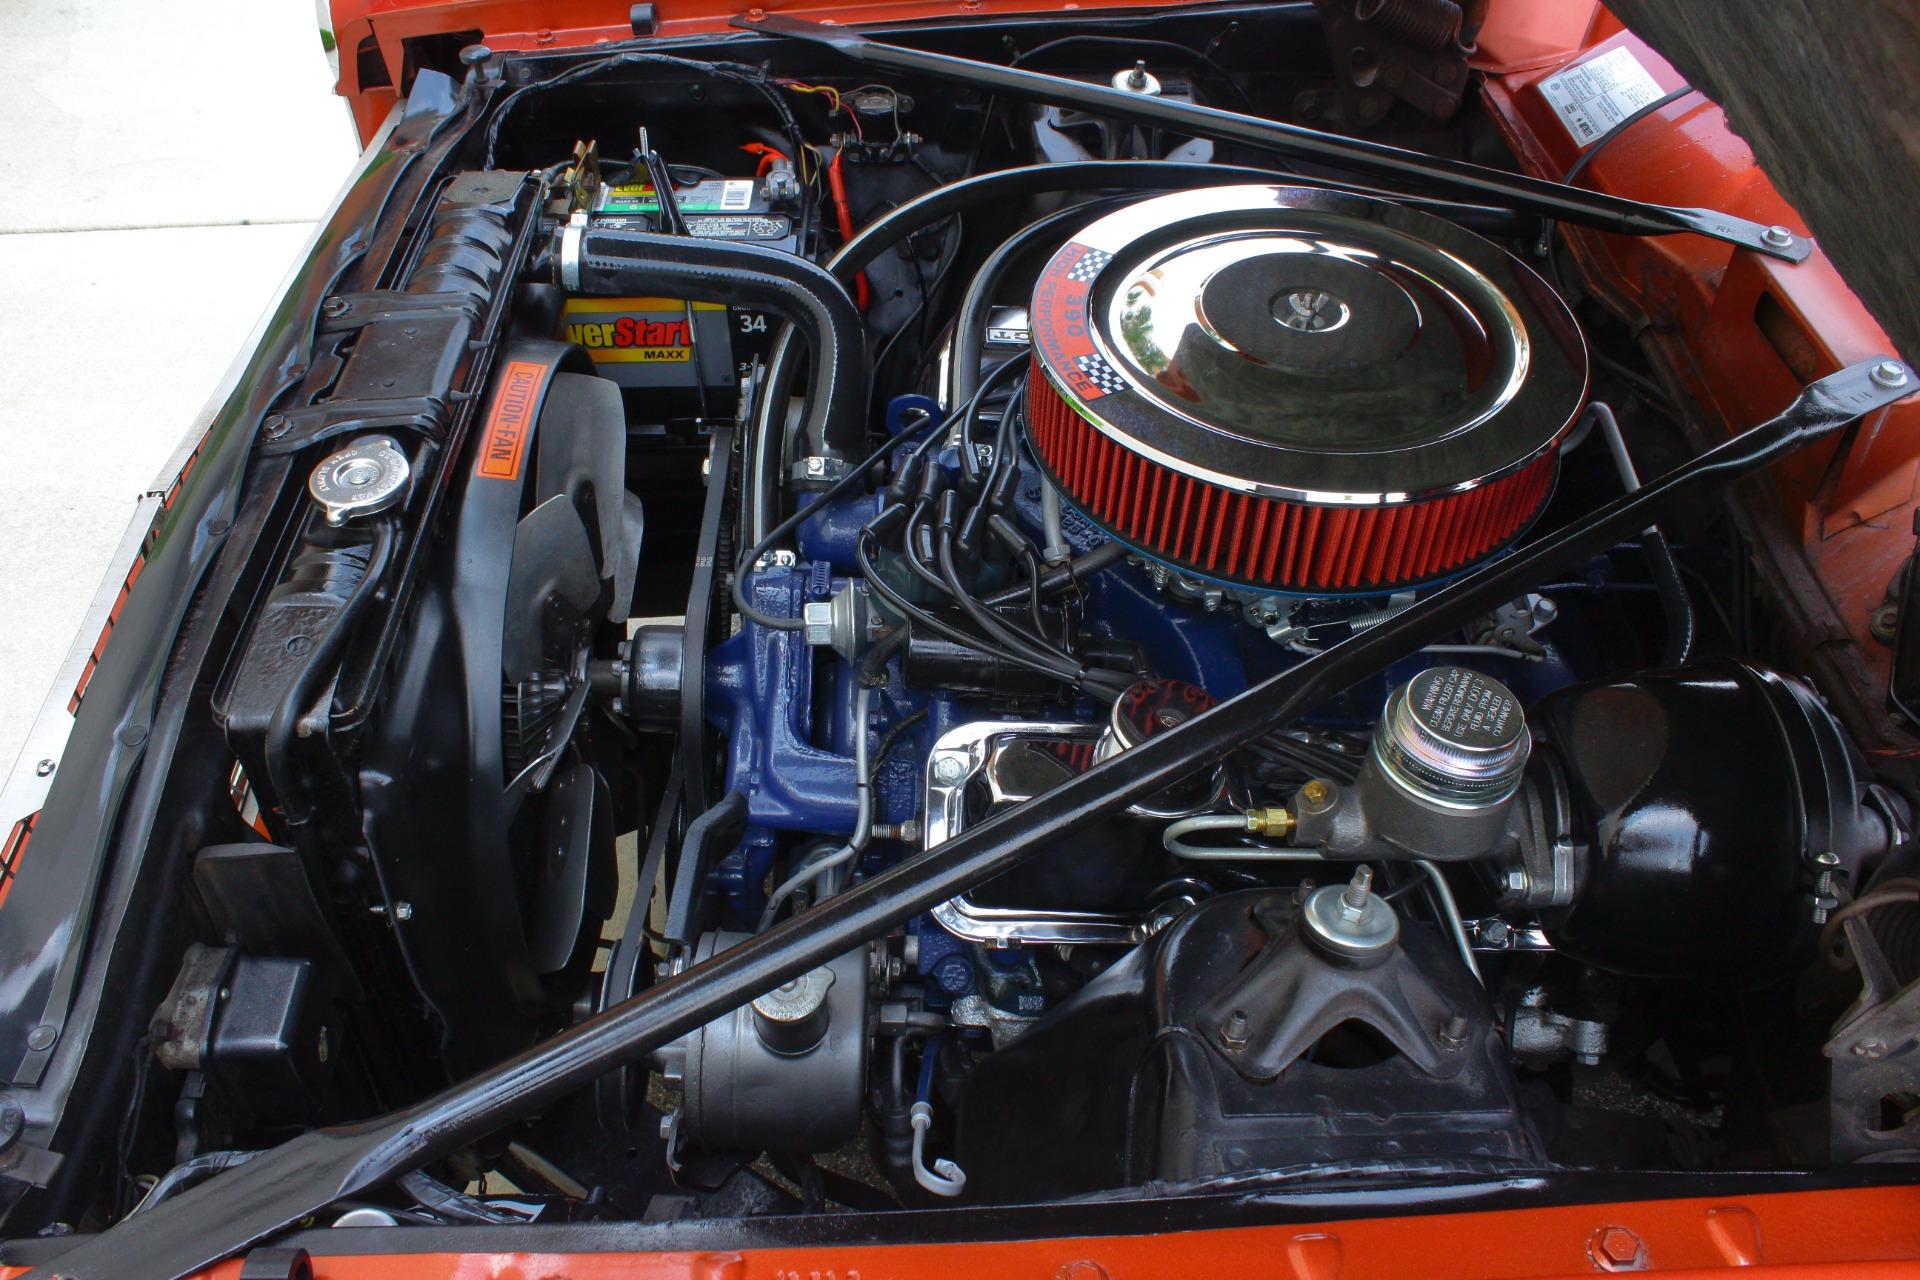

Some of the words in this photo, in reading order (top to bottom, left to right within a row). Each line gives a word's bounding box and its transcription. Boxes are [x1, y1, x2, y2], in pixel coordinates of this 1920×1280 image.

[1050, 248, 1078, 277] HIGH
[740, 314, 768, 333] 34
[1064, 294, 1084, 337] 390
[567, 317, 692, 347] verStart
[1038, 281, 1095, 393] PERFORMANCE
[643, 350, 685, 359] MAXX
[1421, 675, 1444, 711] WARNING
[1467, 684, 1482, 702] DOT
[1474, 678, 1485, 686] 3
[1430, 705, 1445, 728] CLEAN
[1438, 683, 1455, 706] FILLER
[1448, 669, 1460, 683] CAP
[1441, 705, 1460, 732] BEFORE
[1452, 671, 1473, 707] REMOVING
[1461, 702, 1474, 721] ONLY
[1470, 711, 1484, 731] FLUID
[1478, 689, 1493, 710] FROM
[1486, 695, 1503, 721] SEALED
[1453, 722, 1467, 737] USE
[1492, 699, 1512, 737] CONTAINER
